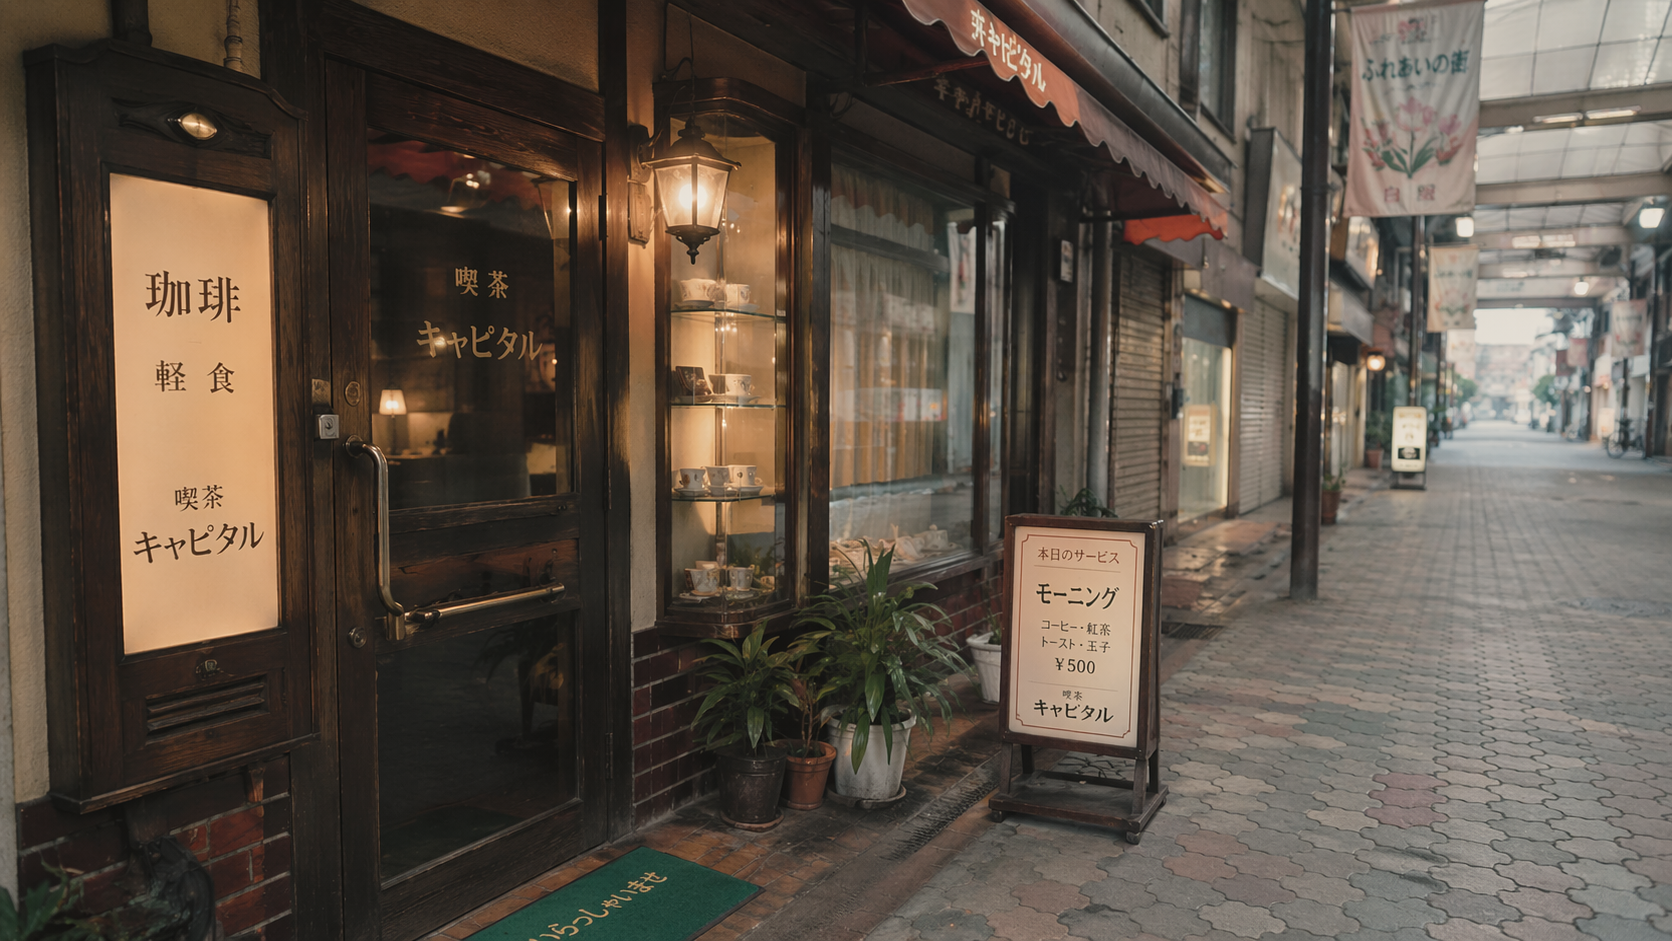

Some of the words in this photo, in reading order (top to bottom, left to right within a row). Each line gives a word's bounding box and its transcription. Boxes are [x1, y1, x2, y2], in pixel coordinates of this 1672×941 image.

[1362, 49, 1470, 82] ふれあいの街
[145, 270, 241, 323] 珈琲
[455, 266, 509, 299] 喫茶
[416, 320, 543, 361] キャピタル
[154, 360, 235, 394] 軽食
[174, 484, 224, 512] 喫茶
[133, 521, 264, 564] キャピタル
[1037, 546, 1120, 565] 本日のサービス
[1036, 582, 1120, 610] モーニング
[1055, 656, 1096, 675] ¥500
